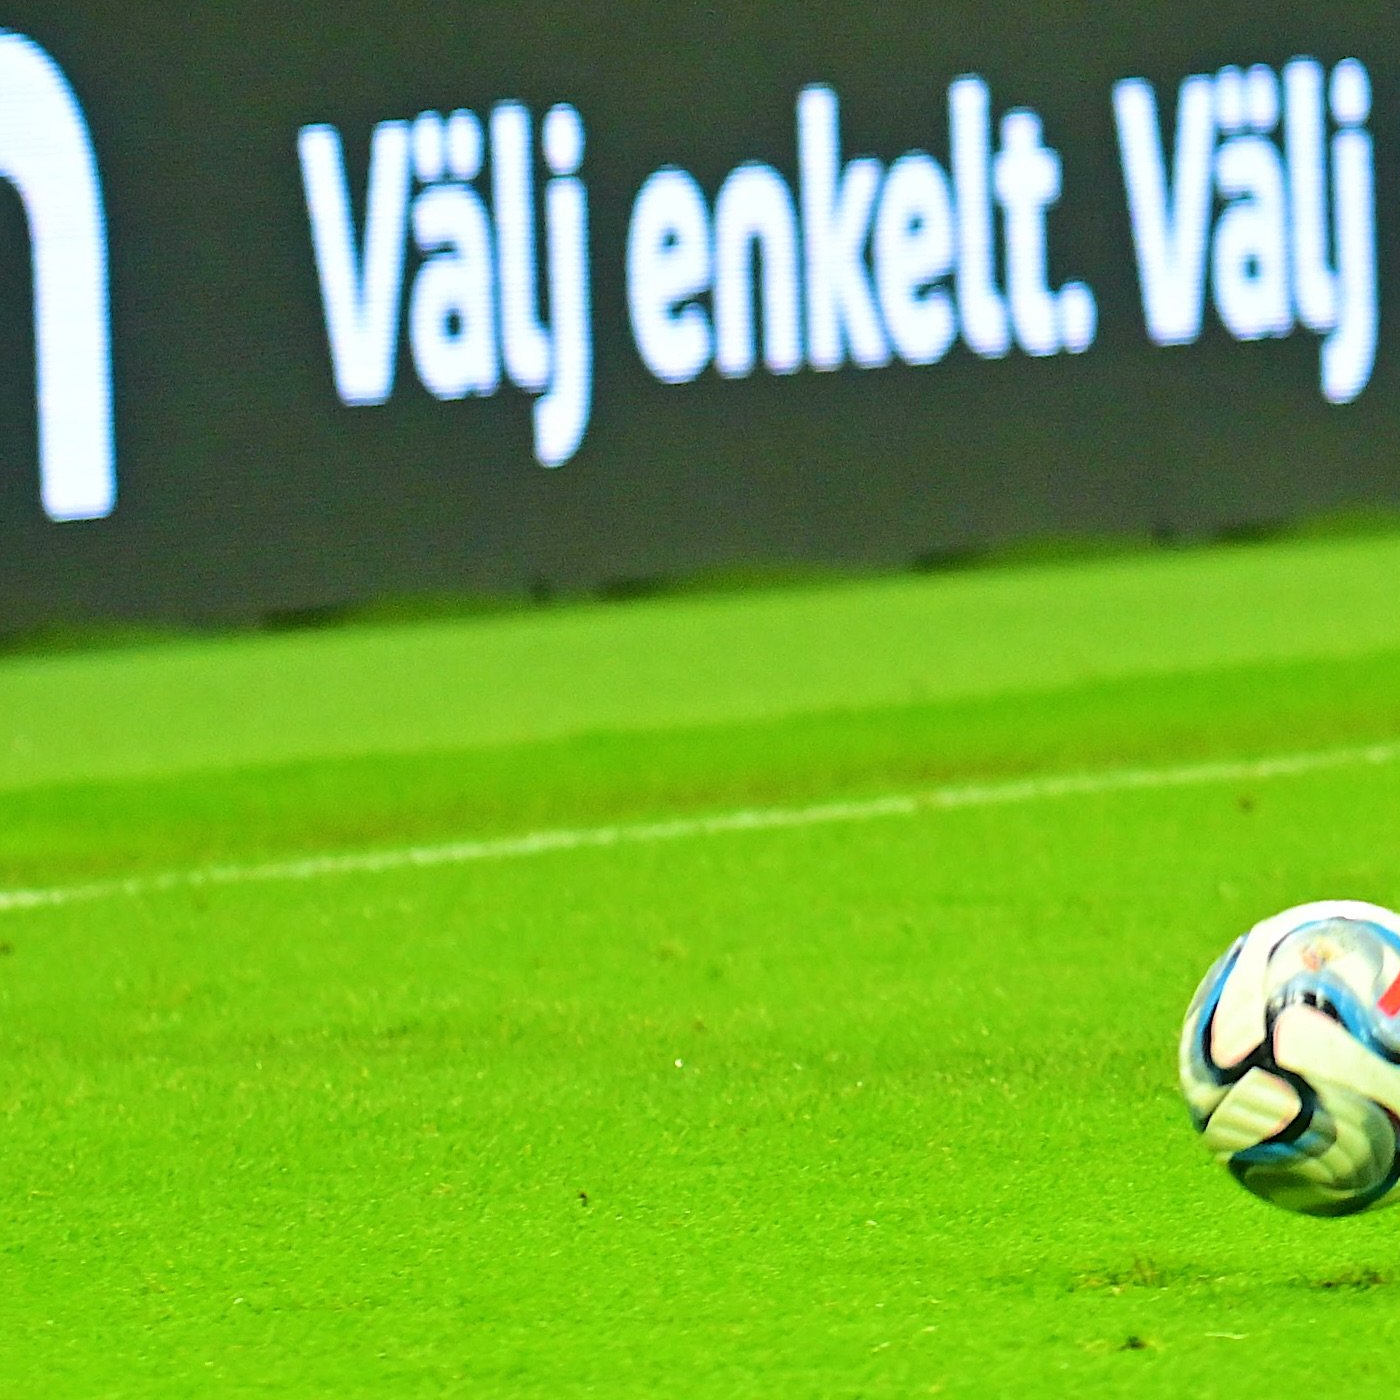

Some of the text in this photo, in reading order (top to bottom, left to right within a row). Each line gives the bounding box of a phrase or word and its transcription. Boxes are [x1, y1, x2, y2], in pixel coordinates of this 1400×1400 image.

[297, 98, 594, 469] Välj
[626, 72, 1098, 386] enkelt.
[1112, 54, 1380, 405] Välj
